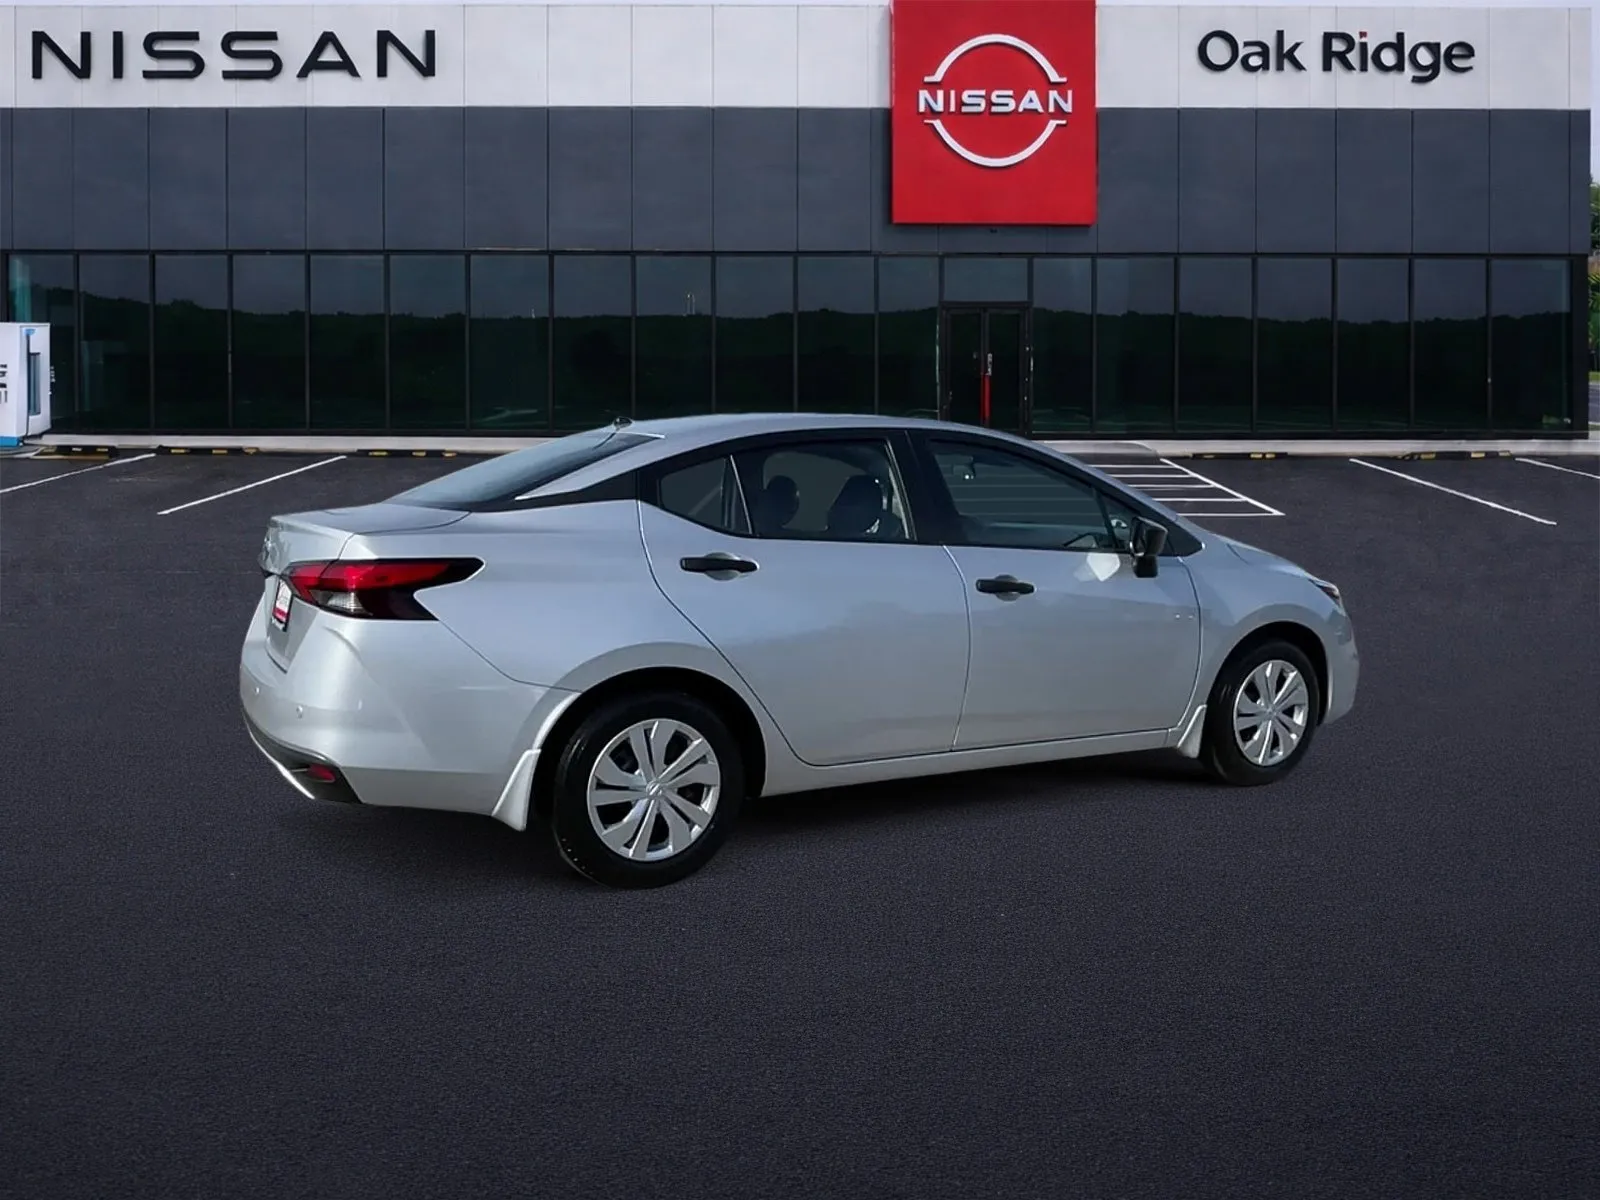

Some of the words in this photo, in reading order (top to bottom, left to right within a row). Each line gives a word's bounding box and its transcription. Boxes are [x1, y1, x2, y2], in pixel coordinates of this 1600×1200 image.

[32, 30, 436, 79] NISSAN
[1198, 30, 1306, 73] Oak
[1322, 31, 1475, 83] Ridge
[918, 89, 1073, 113] NISSAN
